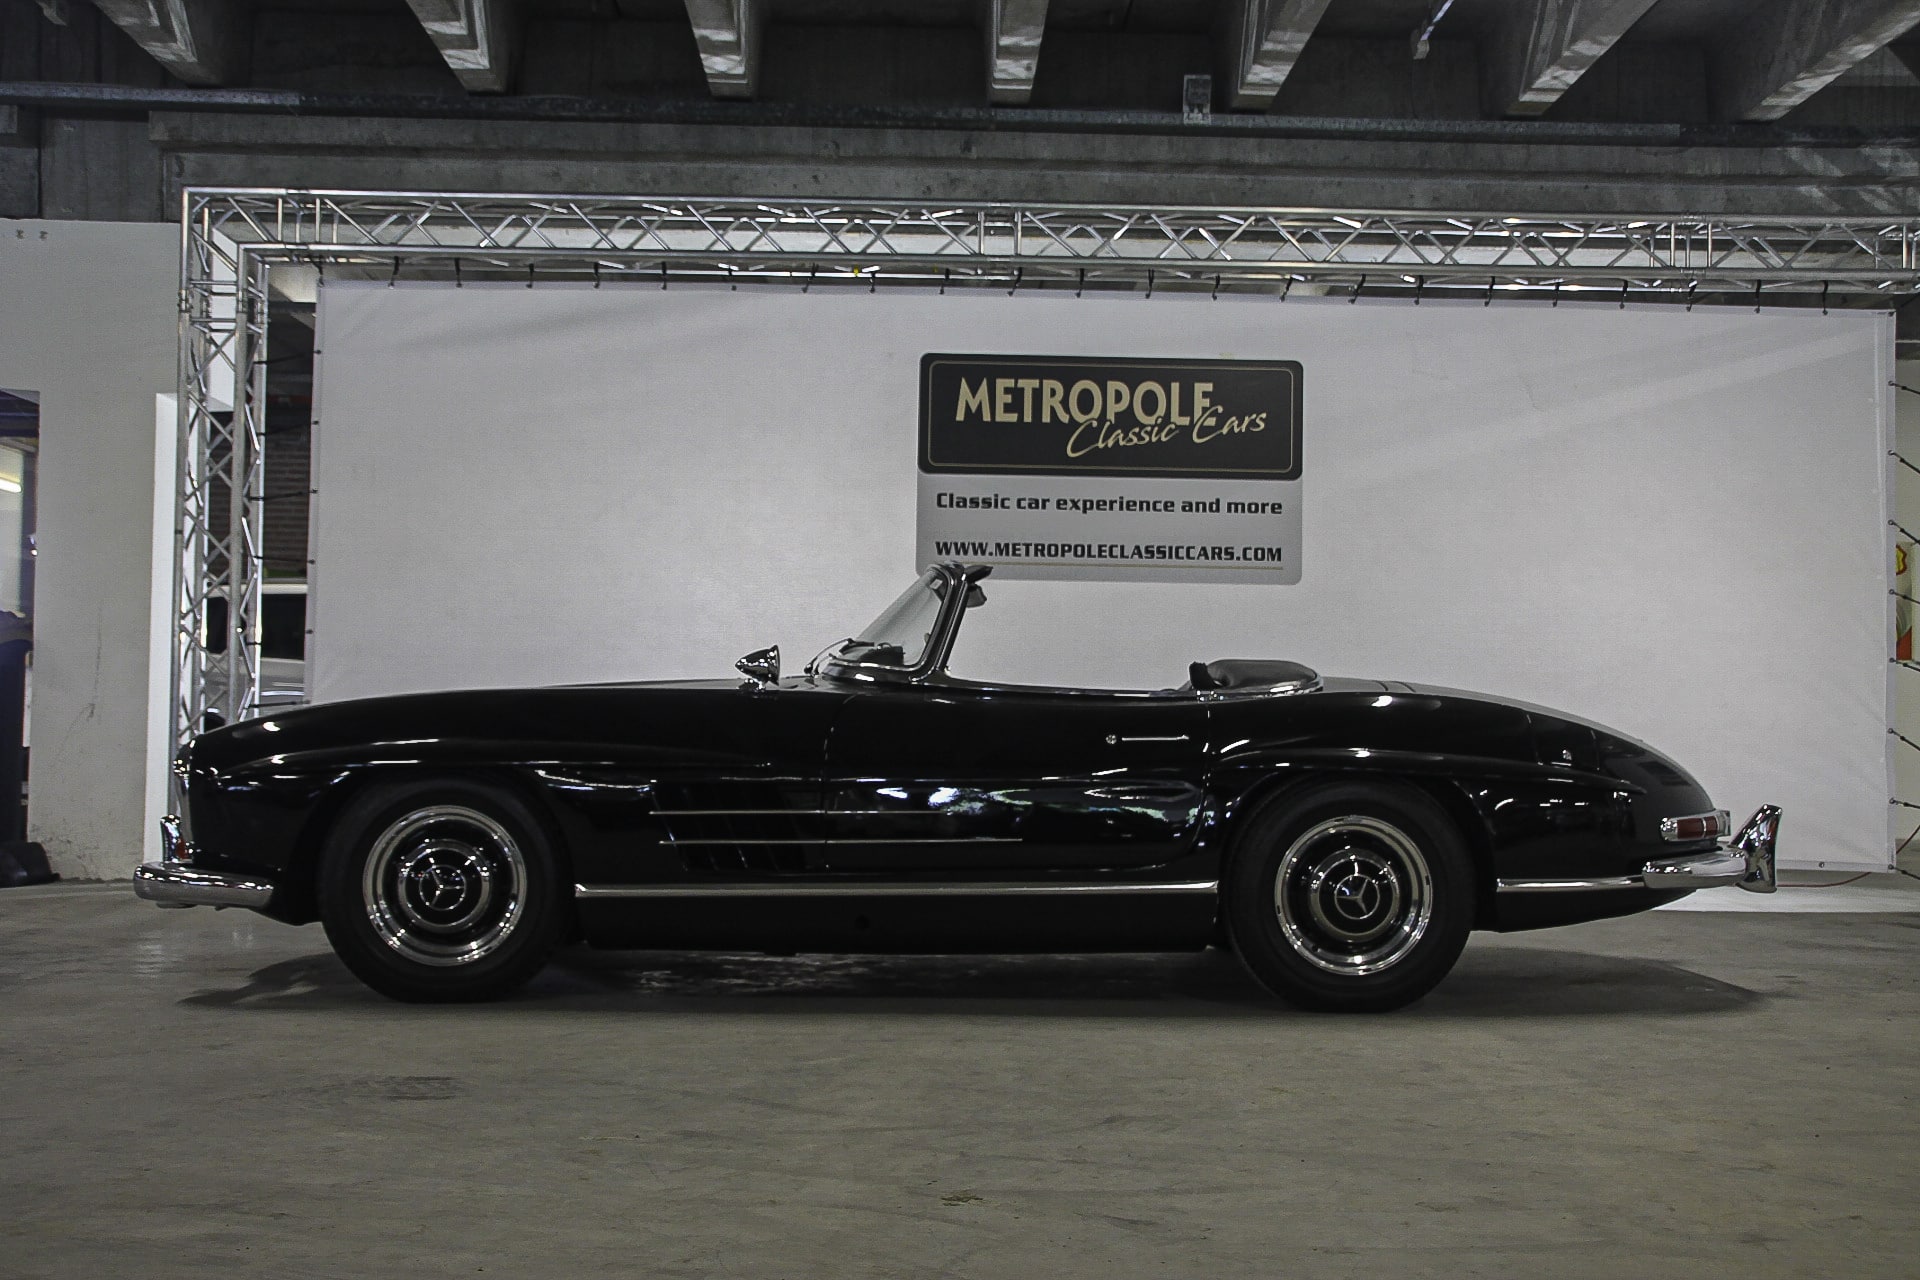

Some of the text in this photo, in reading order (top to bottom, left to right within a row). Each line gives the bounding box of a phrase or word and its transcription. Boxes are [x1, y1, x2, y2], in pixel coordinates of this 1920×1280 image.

[955, 376, 1216, 425] METROPOLE
[1066, 405, 1267, 457] Classic Cars
[936, 492, 1283, 515] Classic car experience and more
[935, 541, 1282, 562] WWW.METROPOLECLASSICCARS.COM
